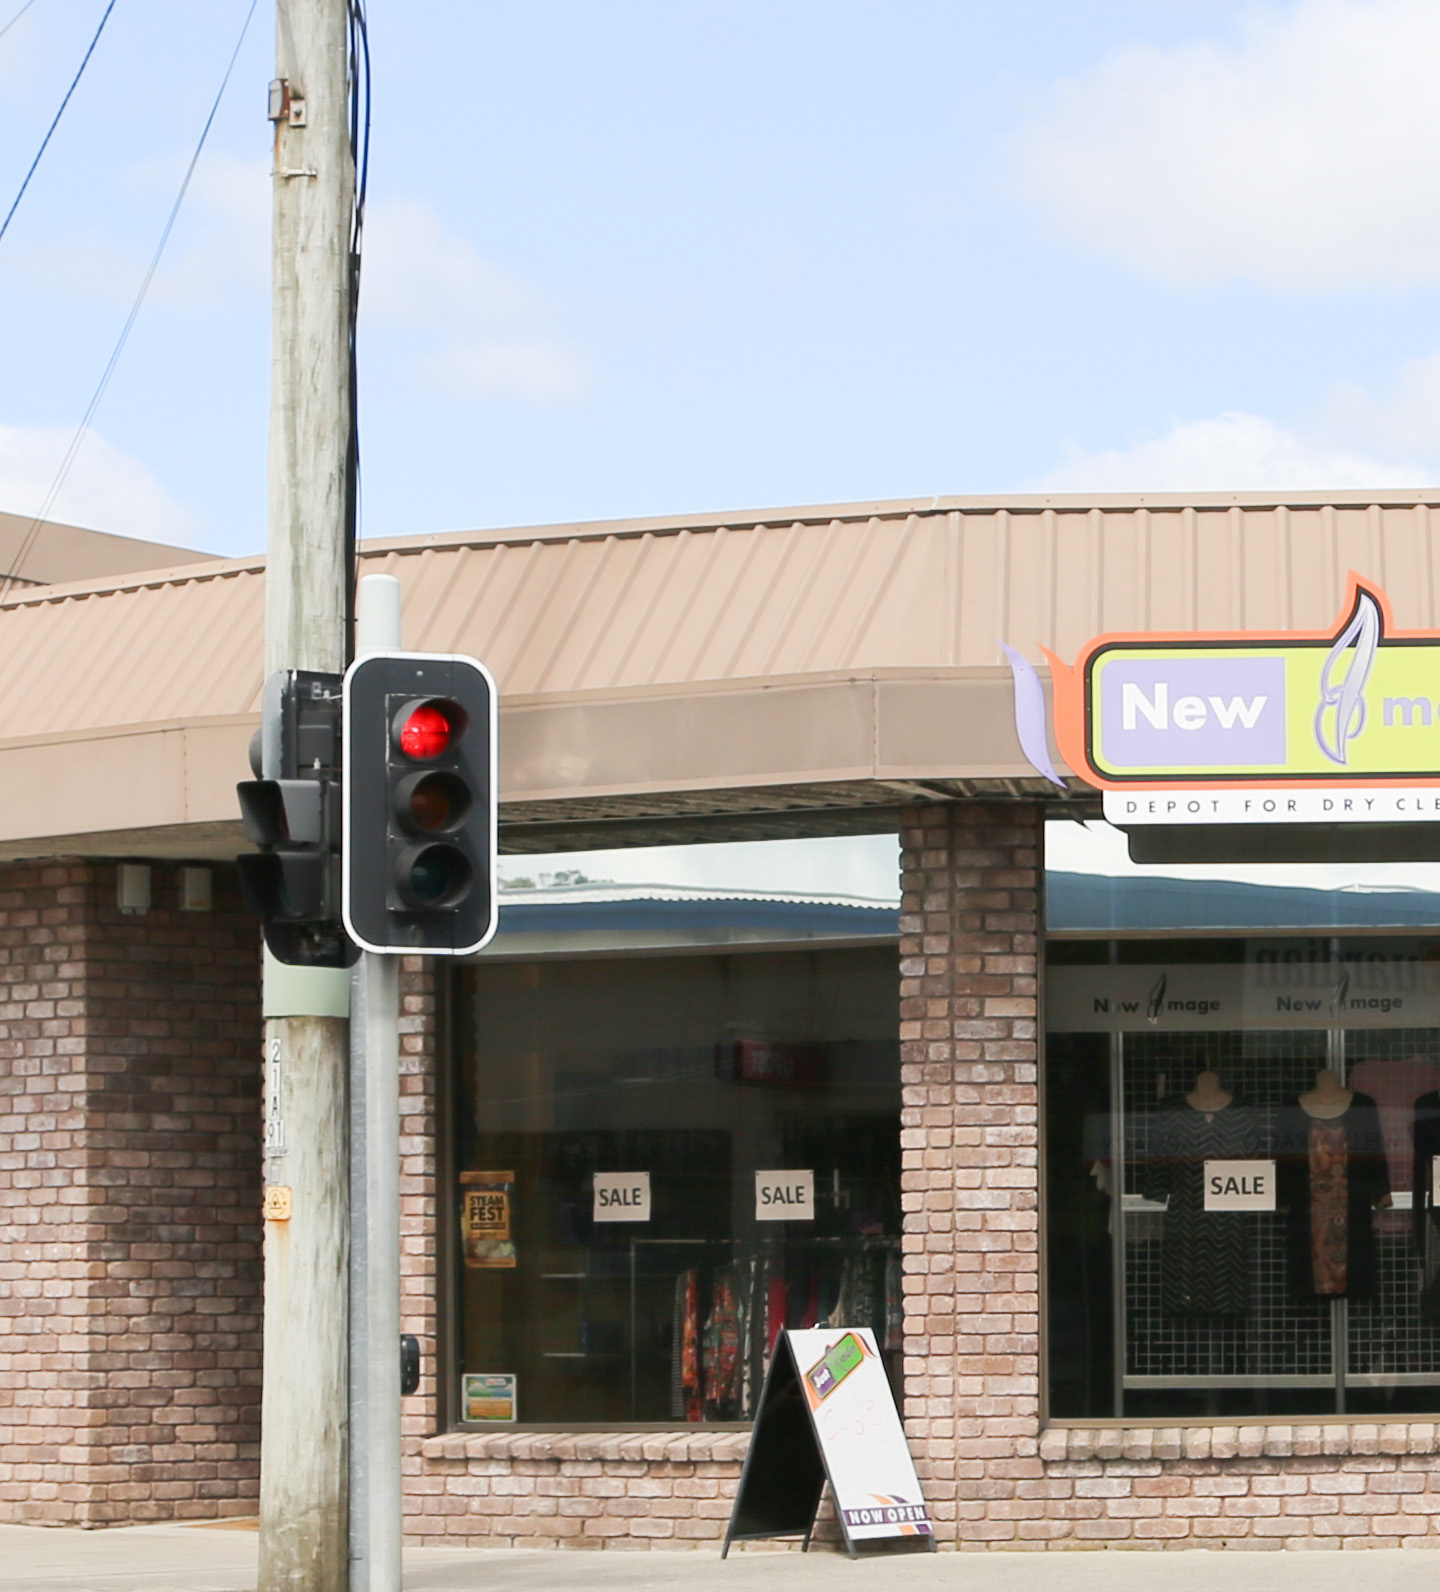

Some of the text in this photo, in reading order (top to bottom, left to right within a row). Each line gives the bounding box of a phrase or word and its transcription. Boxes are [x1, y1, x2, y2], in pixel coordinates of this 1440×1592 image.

[1120, 681, 1269, 732] New
[1126, 800, 1221, 814] DEPOT
[1244, 799, 1298, 813] FOR
[1322, 798, 1376, 812] DRY
[1276, 995, 1323, 1013] New
[1210, 1175, 1265, 1196] SALE
[469, 1195, 505, 1207] STEAM
[598, 1187, 642, 1207] SALE
[761, 1185, 806, 1205] SALE
[469, 1206, 505, 1221] FEST
[849, 1507, 926, 1525] NOW OPEN
